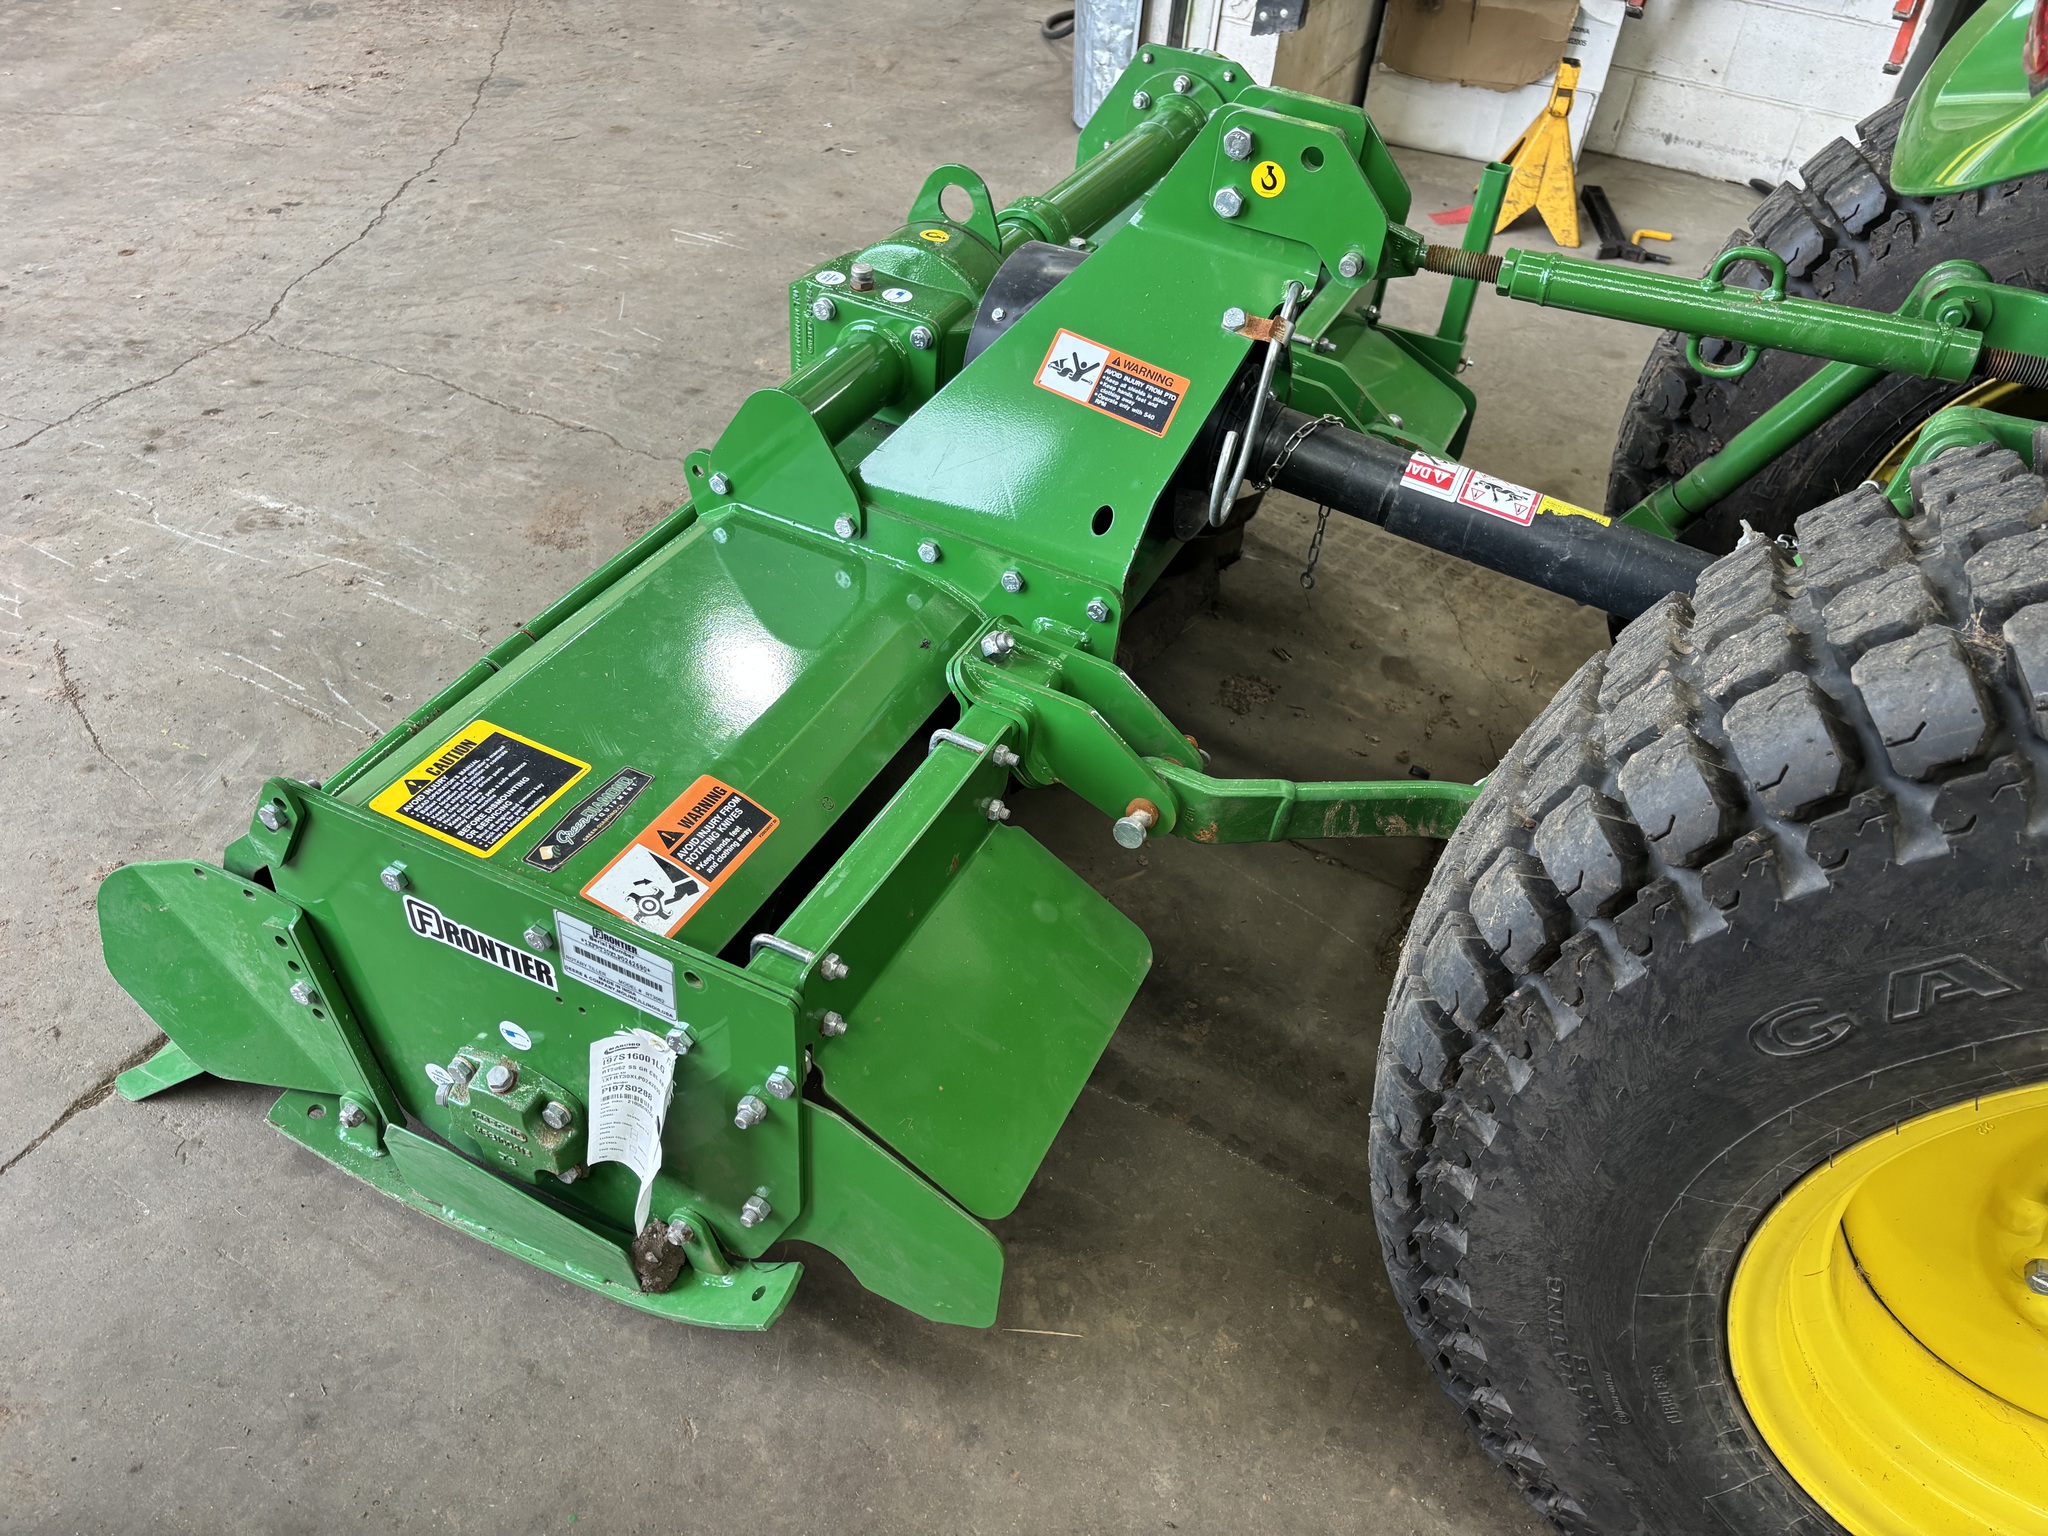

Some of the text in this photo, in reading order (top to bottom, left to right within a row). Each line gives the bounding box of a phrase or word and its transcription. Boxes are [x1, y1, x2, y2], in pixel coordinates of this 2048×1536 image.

[1103, 382, 1116, 391] Keep
[1136, 395, 1146, 403] feet
[1105, 369, 1176, 401] AVOID INJURY FROM PTO
[1105, 376, 1119, 385] Keep
[1128, 387, 1145, 396] shields
[1153, 397, 1168, 405] place
[1124, 361, 1175, 387] WARNING
[1095, 399, 1107, 407] RPM
[1098, 393, 1118, 405] Operate
[1144, 412, 1155, 420] 540
[1100, 389, 1135, 406] clothing away
[1405, 461, 1432, 479] DA
[426, 739, 478, 776] CAUTION
[404, 775, 448, 812] AVOID INJURY
[414, 760, 480, 811] READ OPERATOR'S MANUAL
[431, 809, 445, 819] Keep
[472, 776, 485, 786] place
[447, 816, 461, 826] Keep
[508, 762, 527, 777] distance
[527, 796, 546, 811] machine
[594, 782, 637, 822] EQUIPMENT
[425, 805, 440, 816] Know
[458, 777, 529, 836] BEFORE DISMOUNTING
[466, 801, 512, 839] OR SERVICING
[495, 811, 511, 824] engine
[519, 790, 535, 804] remove
[556, 776, 634, 845] Green DIAMOND
[583, 804, 624, 841] GREEN-DIAMOND.CA
[677, 786, 728, 829] WARNING
[678, 796, 741, 859] AVOID INJURY FROM
[685, 832, 719, 864] ROTATING
[717, 808, 743, 832] KNIVES
[698, 826, 742, 868] Keep hands, feet
[707, 861, 718, 873] and
[717, 841, 740, 862] clothing
[737, 828, 752, 842] away
[407, 899, 554, 987] FRONTIER
[589, 935, 634, 959] Serial Number
[592, 927, 638, 955] FRONTIER
[565, 965, 582, 976] DEERE
[566, 955, 587, 967] ROTARY
[588, 965, 606, 976] TILLER
[619, 980, 636, 991] MODEL
[599, 977, 614, 986] MADE
[622, 987, 636, 996] INDIA
[1748, 937, 2048, 1057] GA
